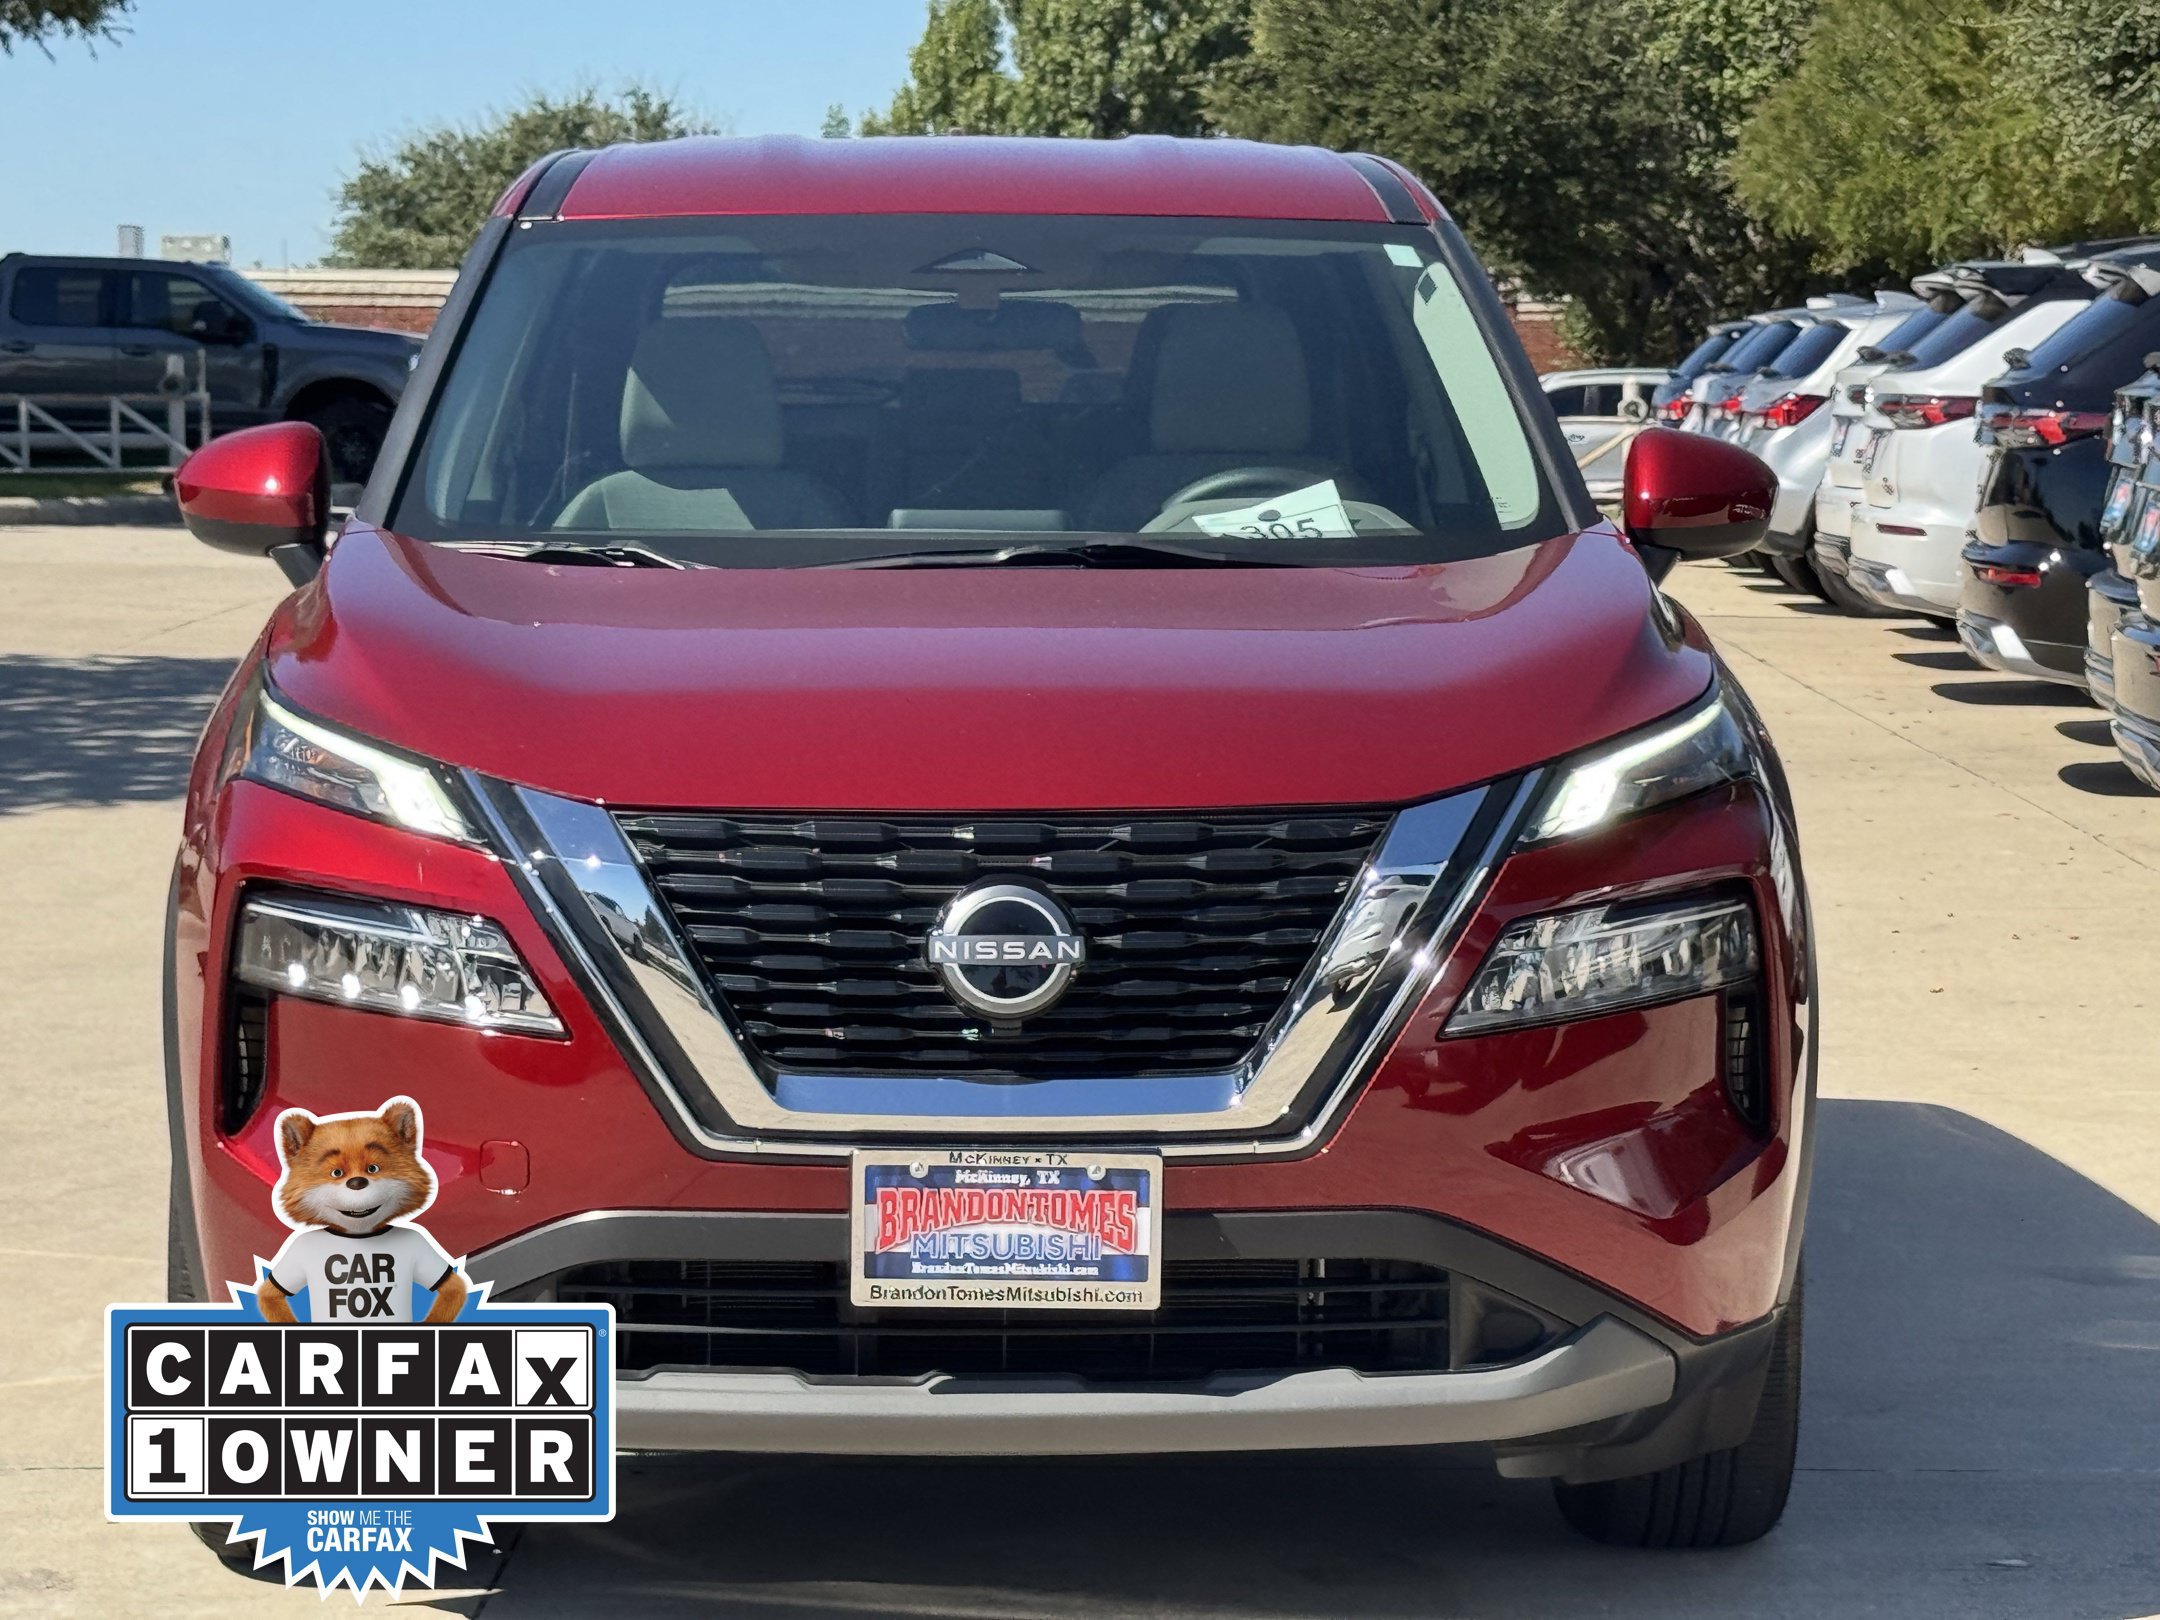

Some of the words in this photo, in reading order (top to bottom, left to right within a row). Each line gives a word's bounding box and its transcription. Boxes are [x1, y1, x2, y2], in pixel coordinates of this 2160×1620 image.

[934, 940, 1080, 960] NISSAN
[1046, 1153, 1068, 1165] TX
[1037, 1170, 1061, 1185] TX
[910, 1232, 1103, 1261] MITSUBISHI
[870, 1285, 1143, 1303] BrandonTomesMitsubishi.com
